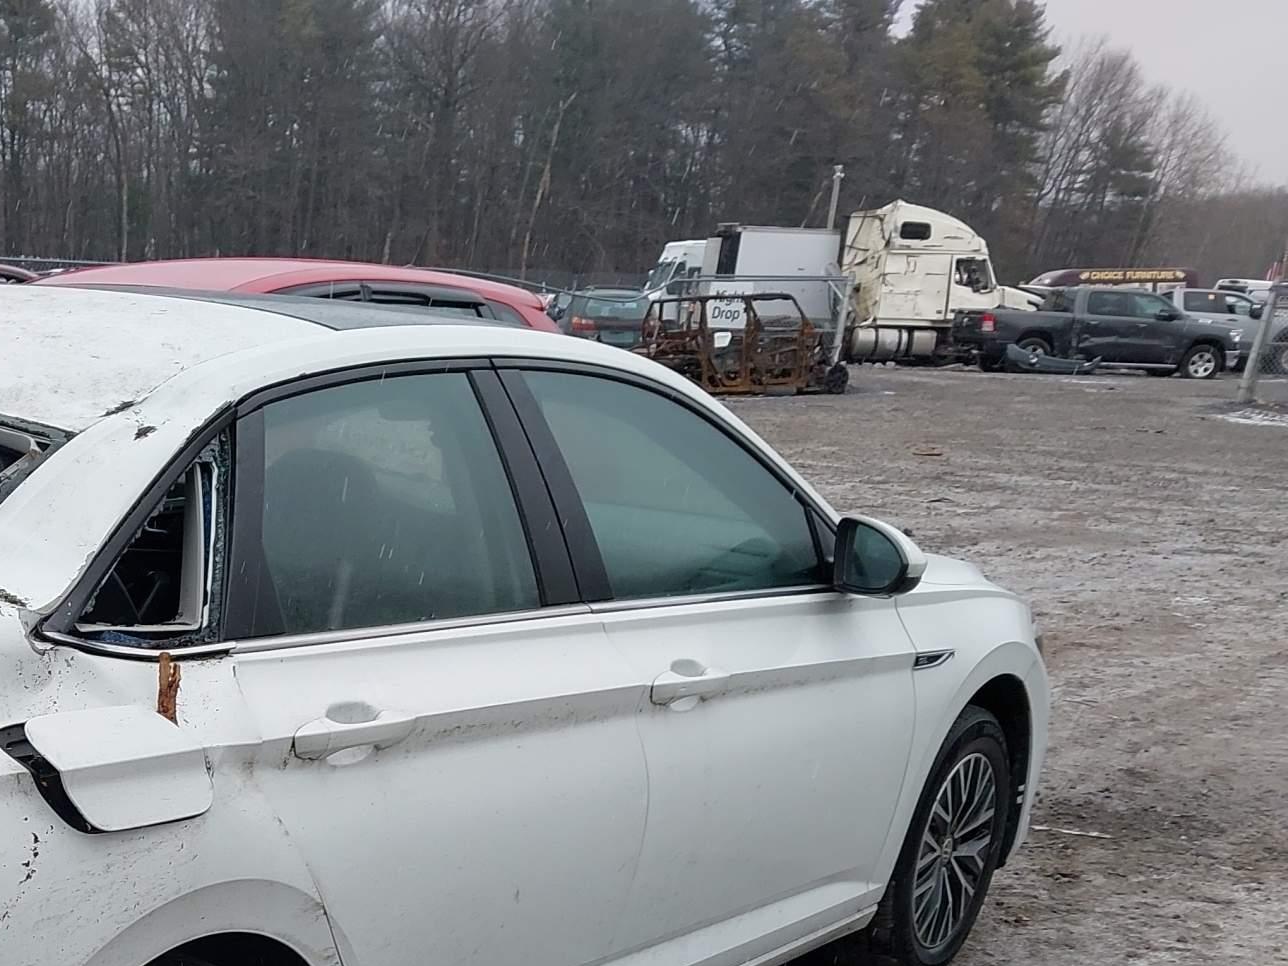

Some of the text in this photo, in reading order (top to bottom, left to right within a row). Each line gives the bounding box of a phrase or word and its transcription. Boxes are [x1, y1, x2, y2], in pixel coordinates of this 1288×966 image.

[1090, 270, 1175, 280] CHOICE FURNITURE
[712, 306, 740, 322] Drop
